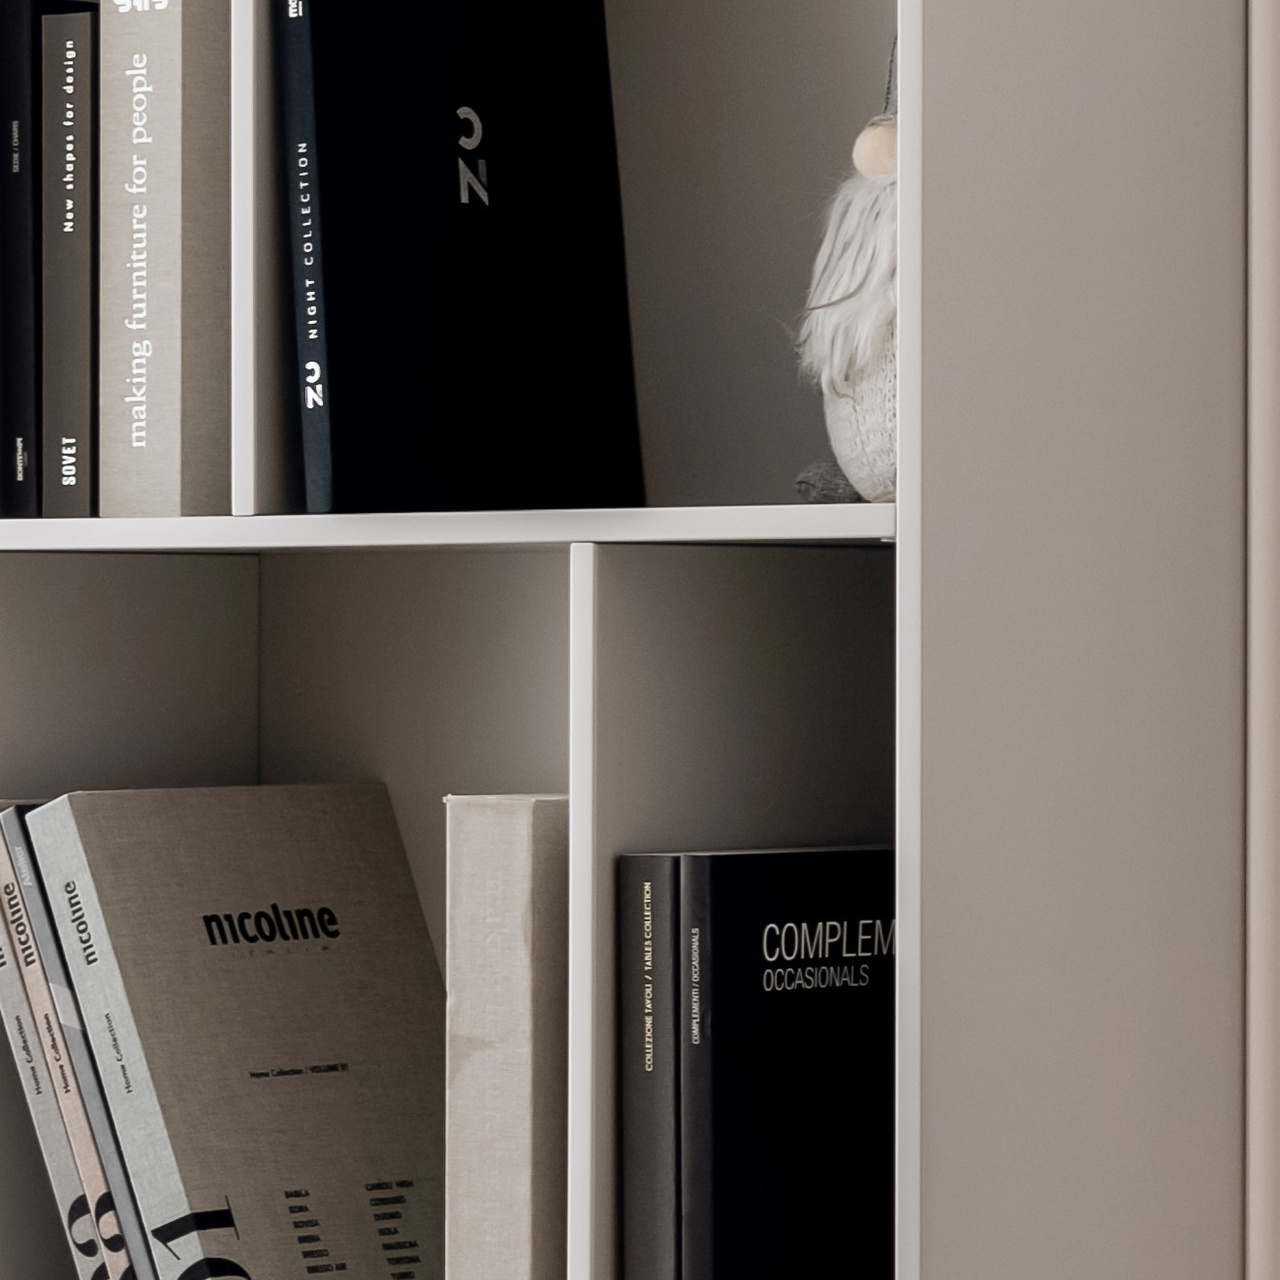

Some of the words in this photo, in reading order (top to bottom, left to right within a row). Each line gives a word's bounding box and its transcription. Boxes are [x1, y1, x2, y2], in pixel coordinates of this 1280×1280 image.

[62, 40, 77, 94] design
[62, 103, 74, 126] for
[124, 53, 152, 145] people
[62, 135, 77, 190] shapes
[124, 154, 147, 195] for
[62, 199, 74, 233] New
[297, 142, 314, 266] COLLECTION
[124, 204, 147, 331] furniture
[305, 278, 319, 339] NIGHT
[124, 340, 149, 448] making
[61, 437, 77, 486] SOVET
[3, 882, 36, 967] nicoline
[64, 881, 98, 966] nicoline
[202, 902, 341, 946] nicoline
[642, 881, 653, 939] COLLECTION
[643, 940, 653, 971] TABLES
[691, 927, 700, 982] OCCASIONALS
[762, 918, 896, 962] COMPLEM
[643, 984, 653, 1013] TAVOLI
[762, 964, 870, 992] OCCASIONALS
[14, 1014, 33, 1063] Collection
[43, 1013, 61, 1062] Collection
[104, 1012, 123, 1062] Collection
[691, 988, 700, 1045] COMPLEMENTI
[644, 1016, 654, 1072] COLLEZIONE
[29, 1066, 42, 1095] Home
[58, 1064, 71, 1094] Home
[120, 1064, 133, 1094] Home
